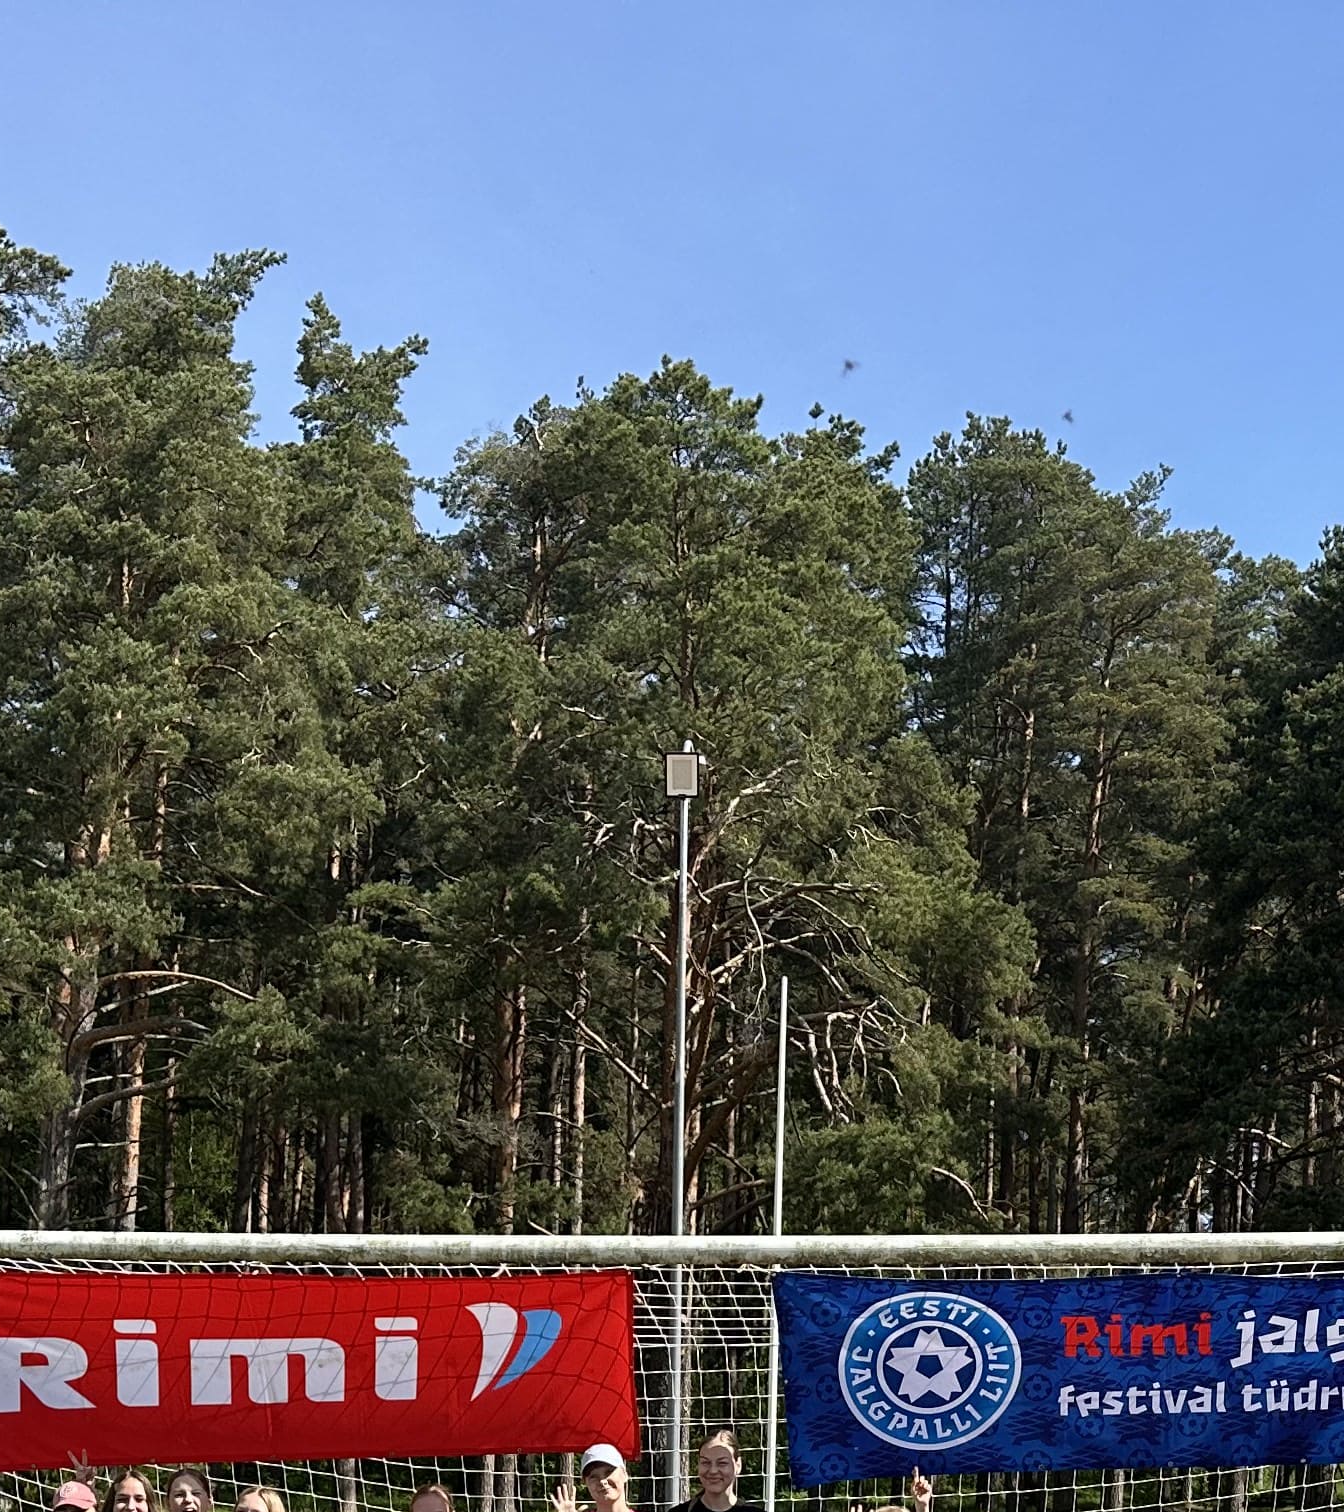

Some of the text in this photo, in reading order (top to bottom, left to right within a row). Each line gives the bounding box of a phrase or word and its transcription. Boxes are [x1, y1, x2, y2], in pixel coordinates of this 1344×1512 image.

[878, 1300, 980, 1328] EESTI
[1059, 1312, 1214, 1360] Rimi
[850, 1345, 982, 1439] JALGPALLI
[979, 1342, 1010, 1402] LIIT
[1058, 1378, 1226, 1418] festival
